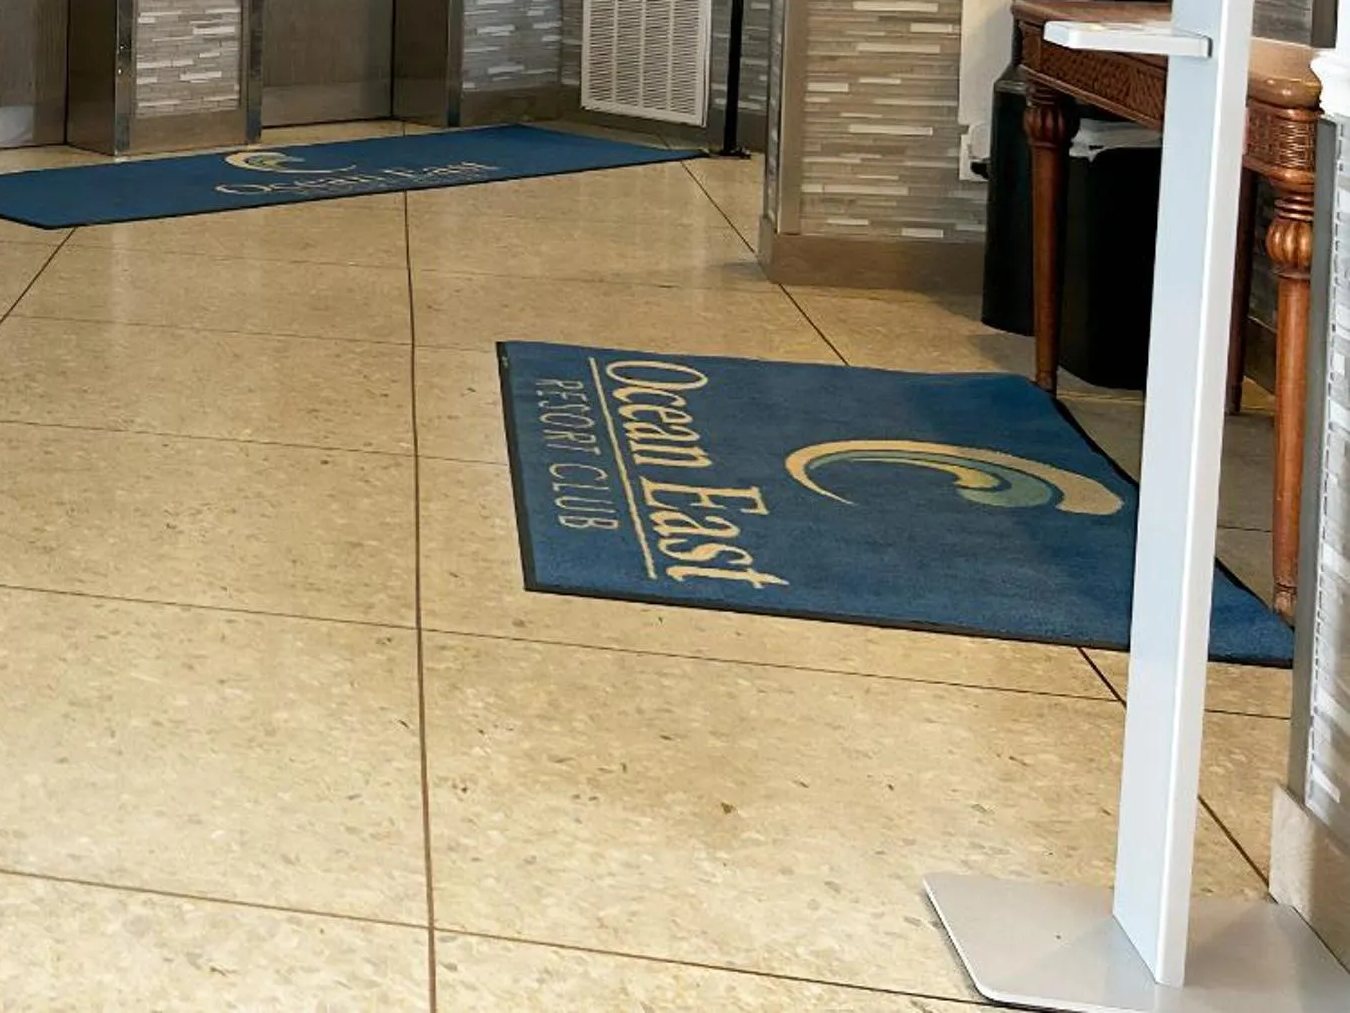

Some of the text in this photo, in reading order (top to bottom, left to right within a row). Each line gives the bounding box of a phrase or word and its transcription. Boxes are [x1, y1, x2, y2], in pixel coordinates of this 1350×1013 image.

[535, 379, 620, 530] RESORT CLUB
[606, 360, 790, 588] Ocean East
